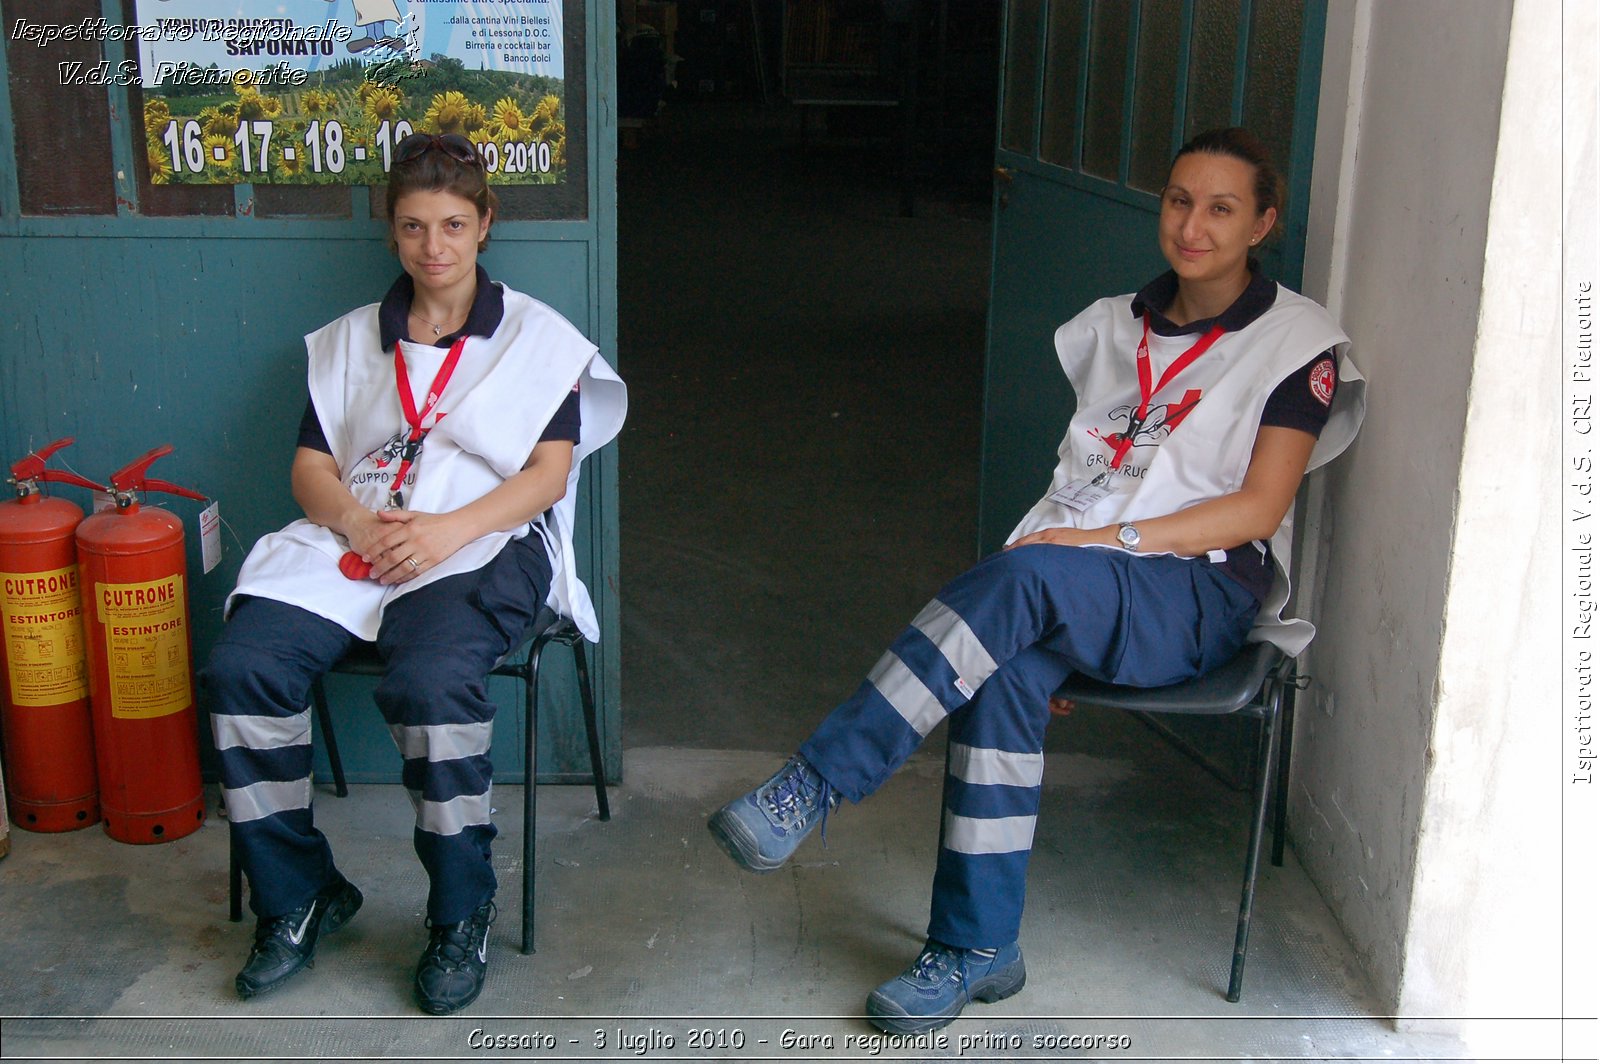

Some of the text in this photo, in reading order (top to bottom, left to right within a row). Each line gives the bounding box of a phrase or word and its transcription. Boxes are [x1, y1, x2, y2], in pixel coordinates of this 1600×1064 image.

[471, 16, 501, 25] cantina
[503, 15, 519, 25] Vini
[521, 15, 550, 25] Biellesi
[471, 28, 551, 38] e di Lessona D.O.C.
[226, 38, 334, 56] SAPONATO
[465, 41, 551, 50] Birreria e cocktail bar
[503, 53, 551, 63] Banco dolci
[164, 119, 205, 173] 16
[234, 120, 274, 173] 17
[305, 119, 345, 174] 18
[503, 141, 551, 174] 2010
[5, 571, 77, 596] CUTRONE
[103, 581, 175, 607] CUTRONE
[10, 606, 81, 624] ESTINTORE
[113, 616, 182, 636] ESTINTORE
